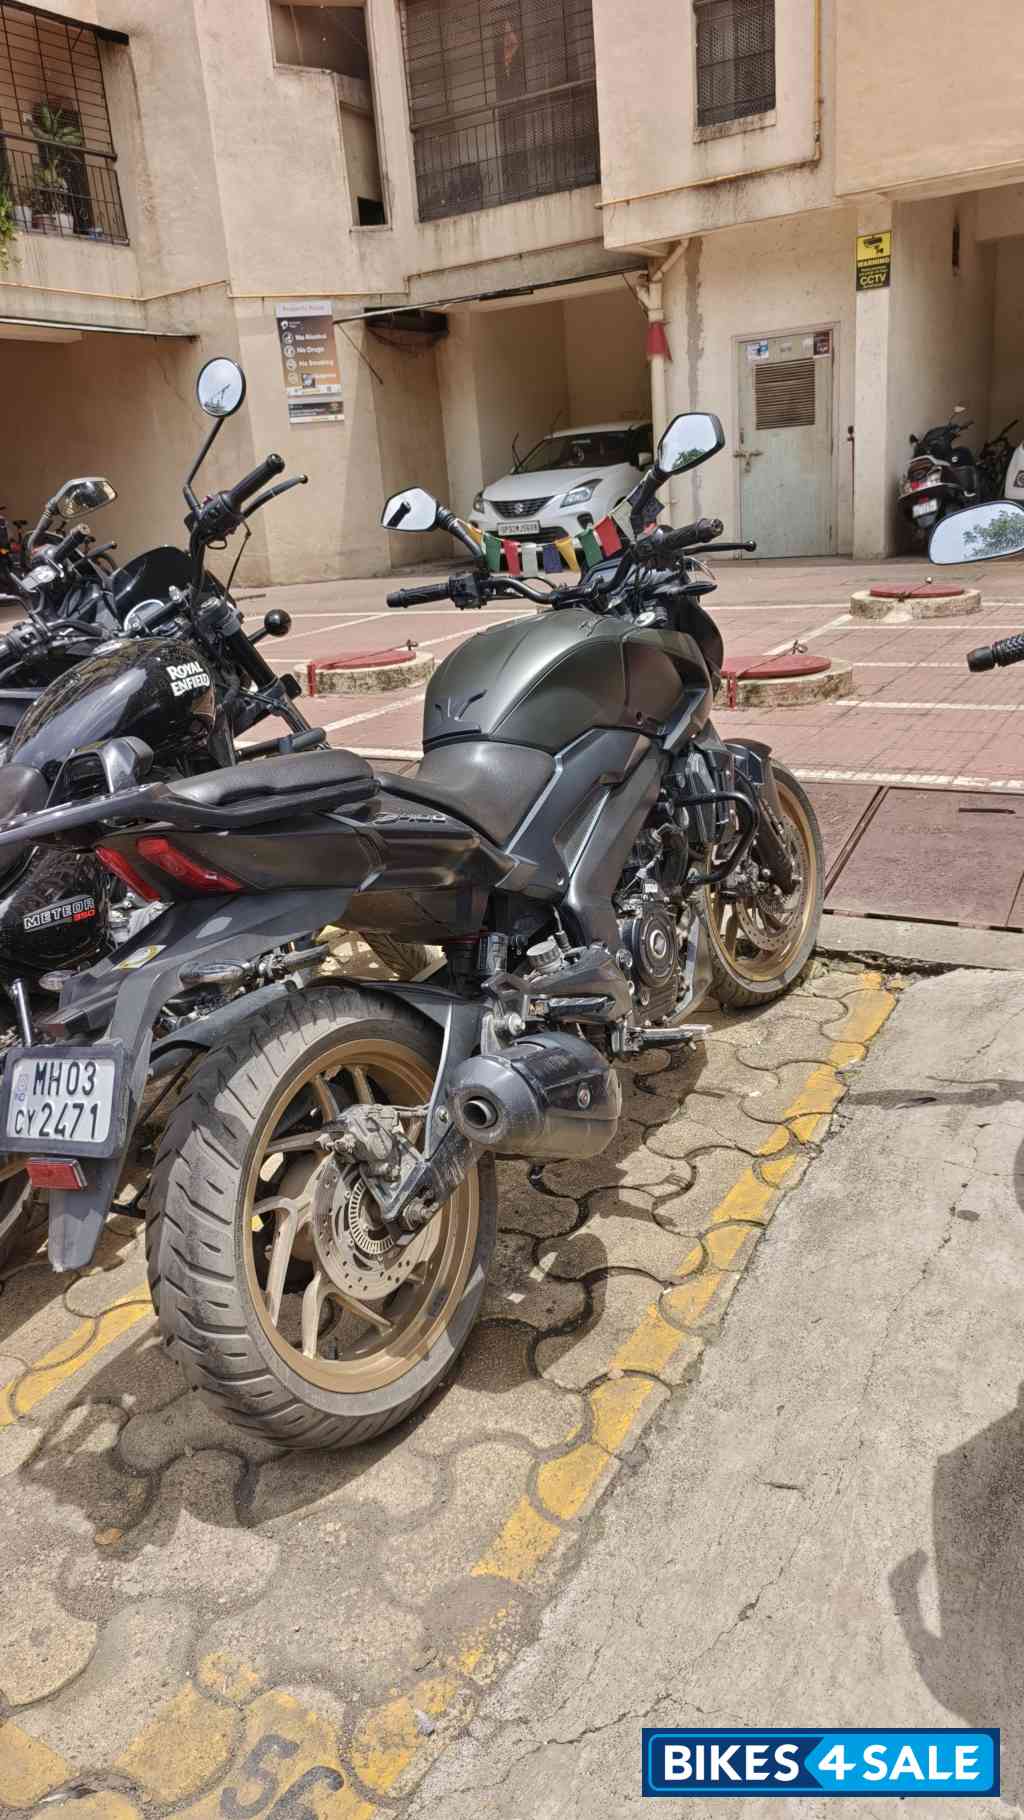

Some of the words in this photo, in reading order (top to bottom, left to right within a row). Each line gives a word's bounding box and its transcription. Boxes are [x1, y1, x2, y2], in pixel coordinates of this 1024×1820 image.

[860, 272, 887, 286] CCTV
[166, 661, 204, 680] ROYAL
[170, 673, 210, 697] ENFIELD
[24, 897, 95, 930] METEOR
[33, 1061, 97, 1096] MH03
